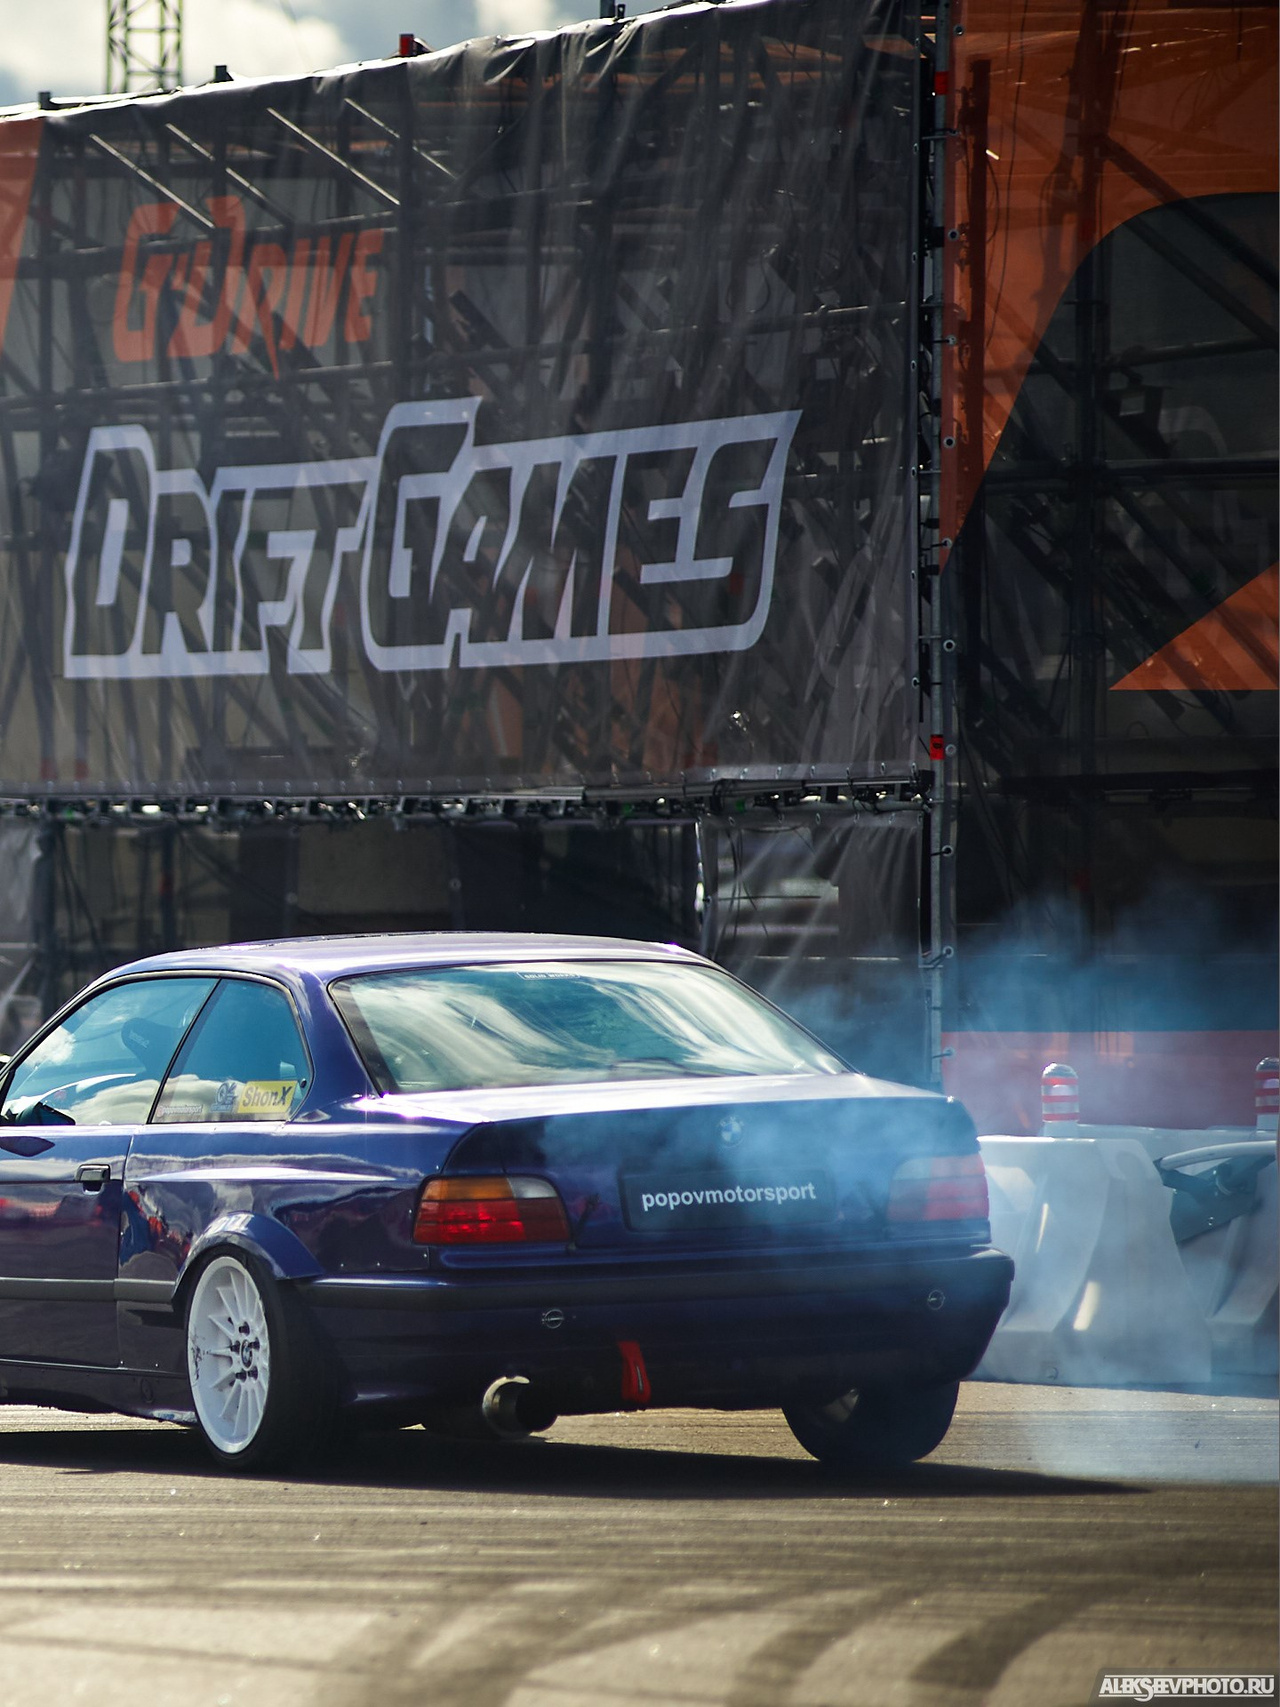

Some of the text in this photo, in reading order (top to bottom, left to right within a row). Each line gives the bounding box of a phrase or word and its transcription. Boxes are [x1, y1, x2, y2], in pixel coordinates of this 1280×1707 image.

[64, 396, 803, 678] DRIFT GAMES
[642, 1183, 816, 1212] popovmotorsport
